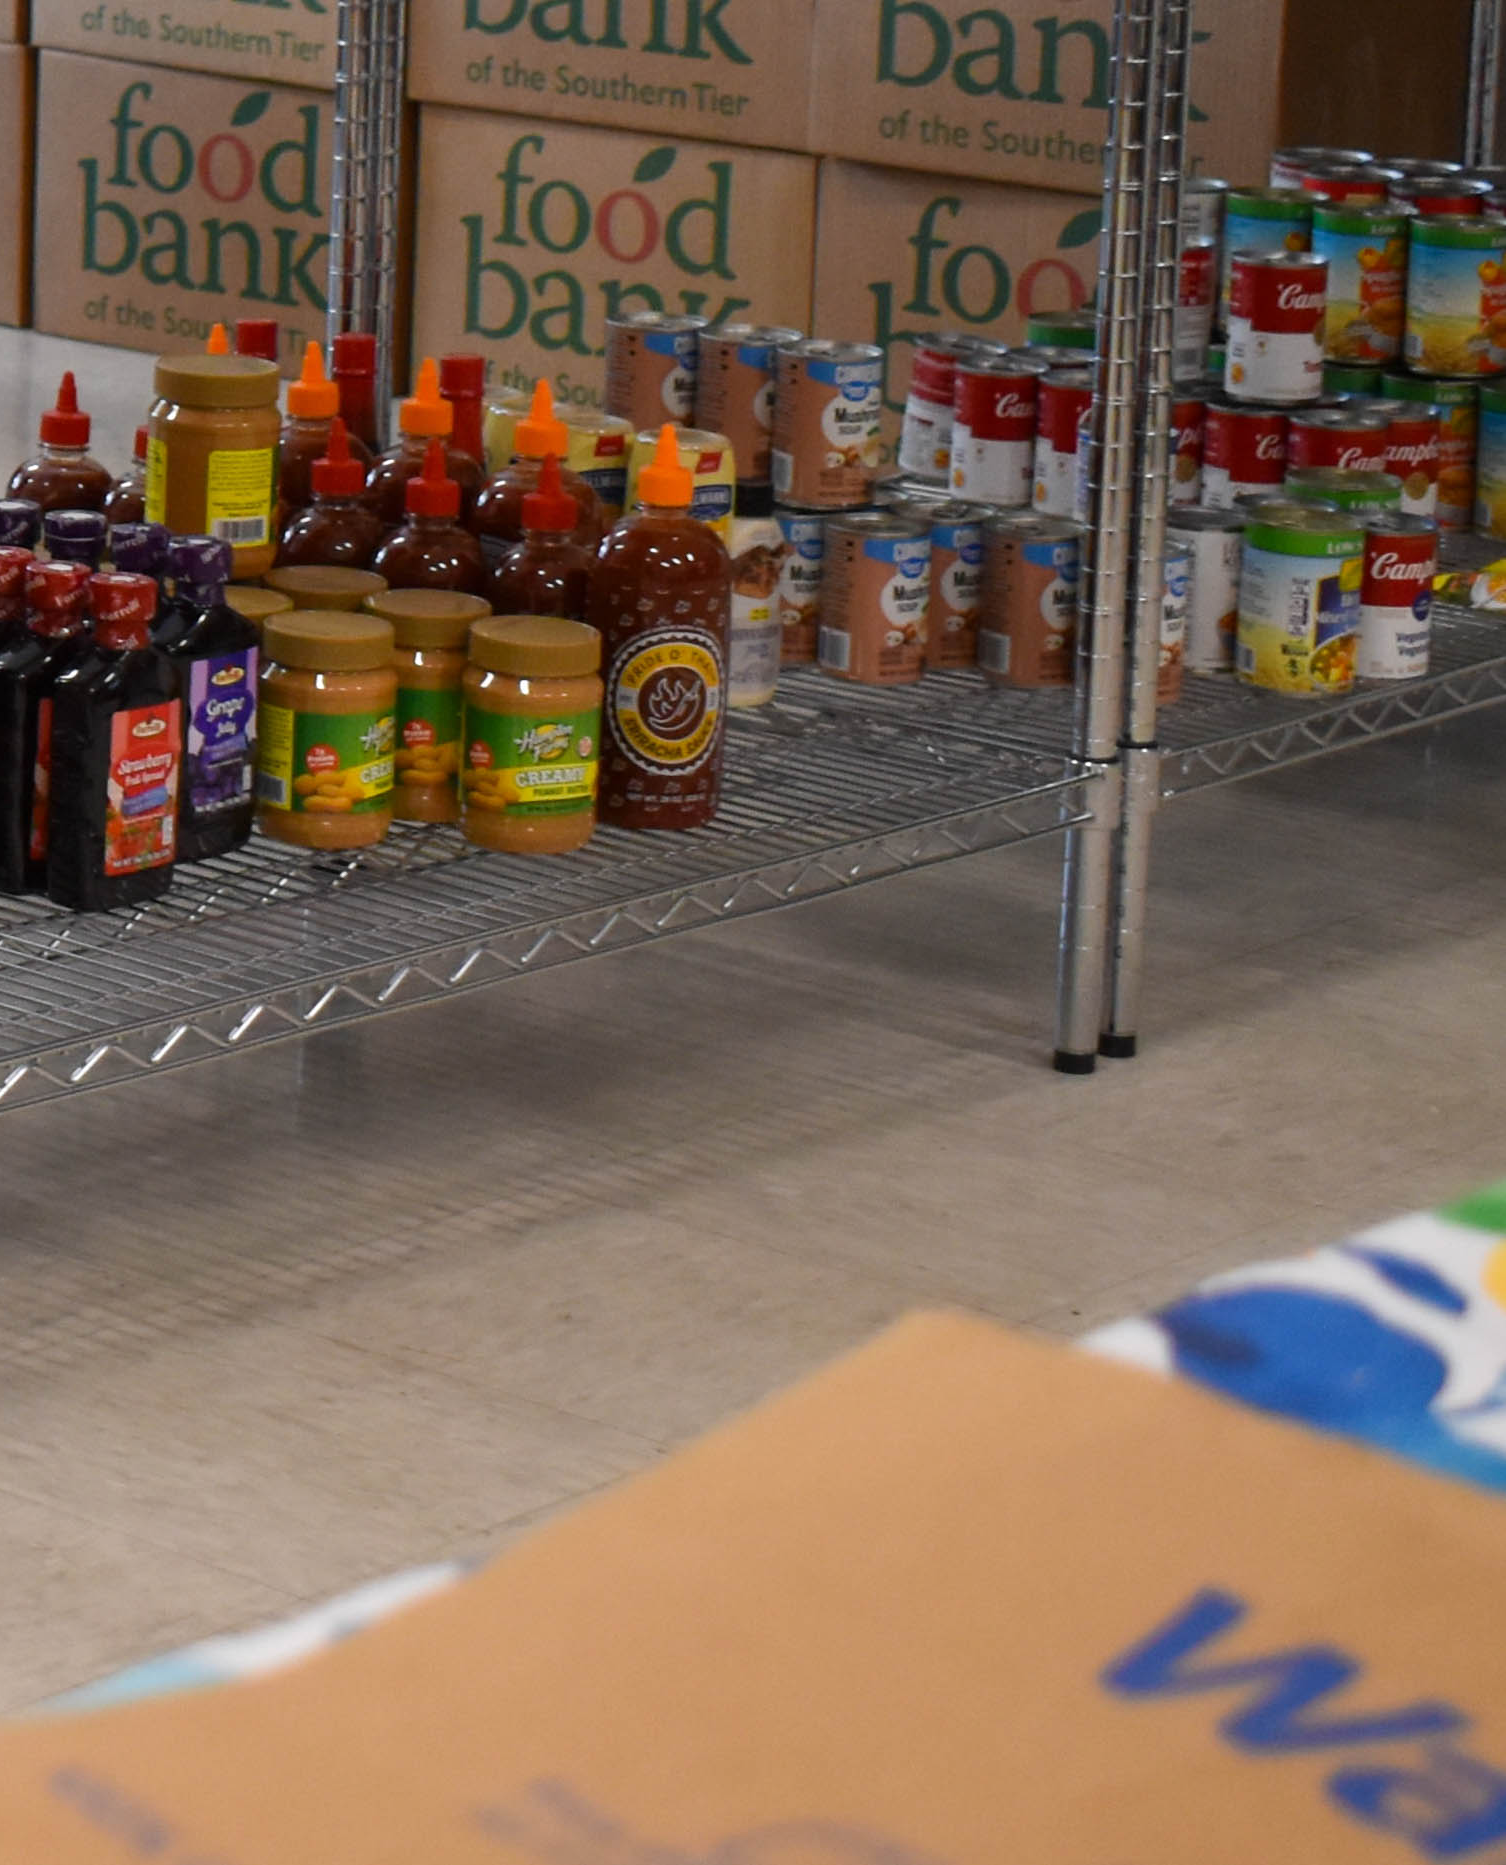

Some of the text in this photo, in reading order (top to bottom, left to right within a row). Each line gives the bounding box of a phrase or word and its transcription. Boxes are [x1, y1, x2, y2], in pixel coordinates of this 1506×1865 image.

[159, 15, 272, 57] Southern
[466, 57, 751, 117] of the Southern Tier
[107, 81, 324, 219] food
[878, 110, 970, 150] of the
[492, 134, 738, 282] food
[78, 158, 330, 315] bank
[902, 196, 1088, 325] foo
[626, 651, 663, 684] PRIDE
[205, 696, 245, 722] Grape
[118, 753, 173, 776] Strawberry
[515, 767, 587, 788] CREAMY
